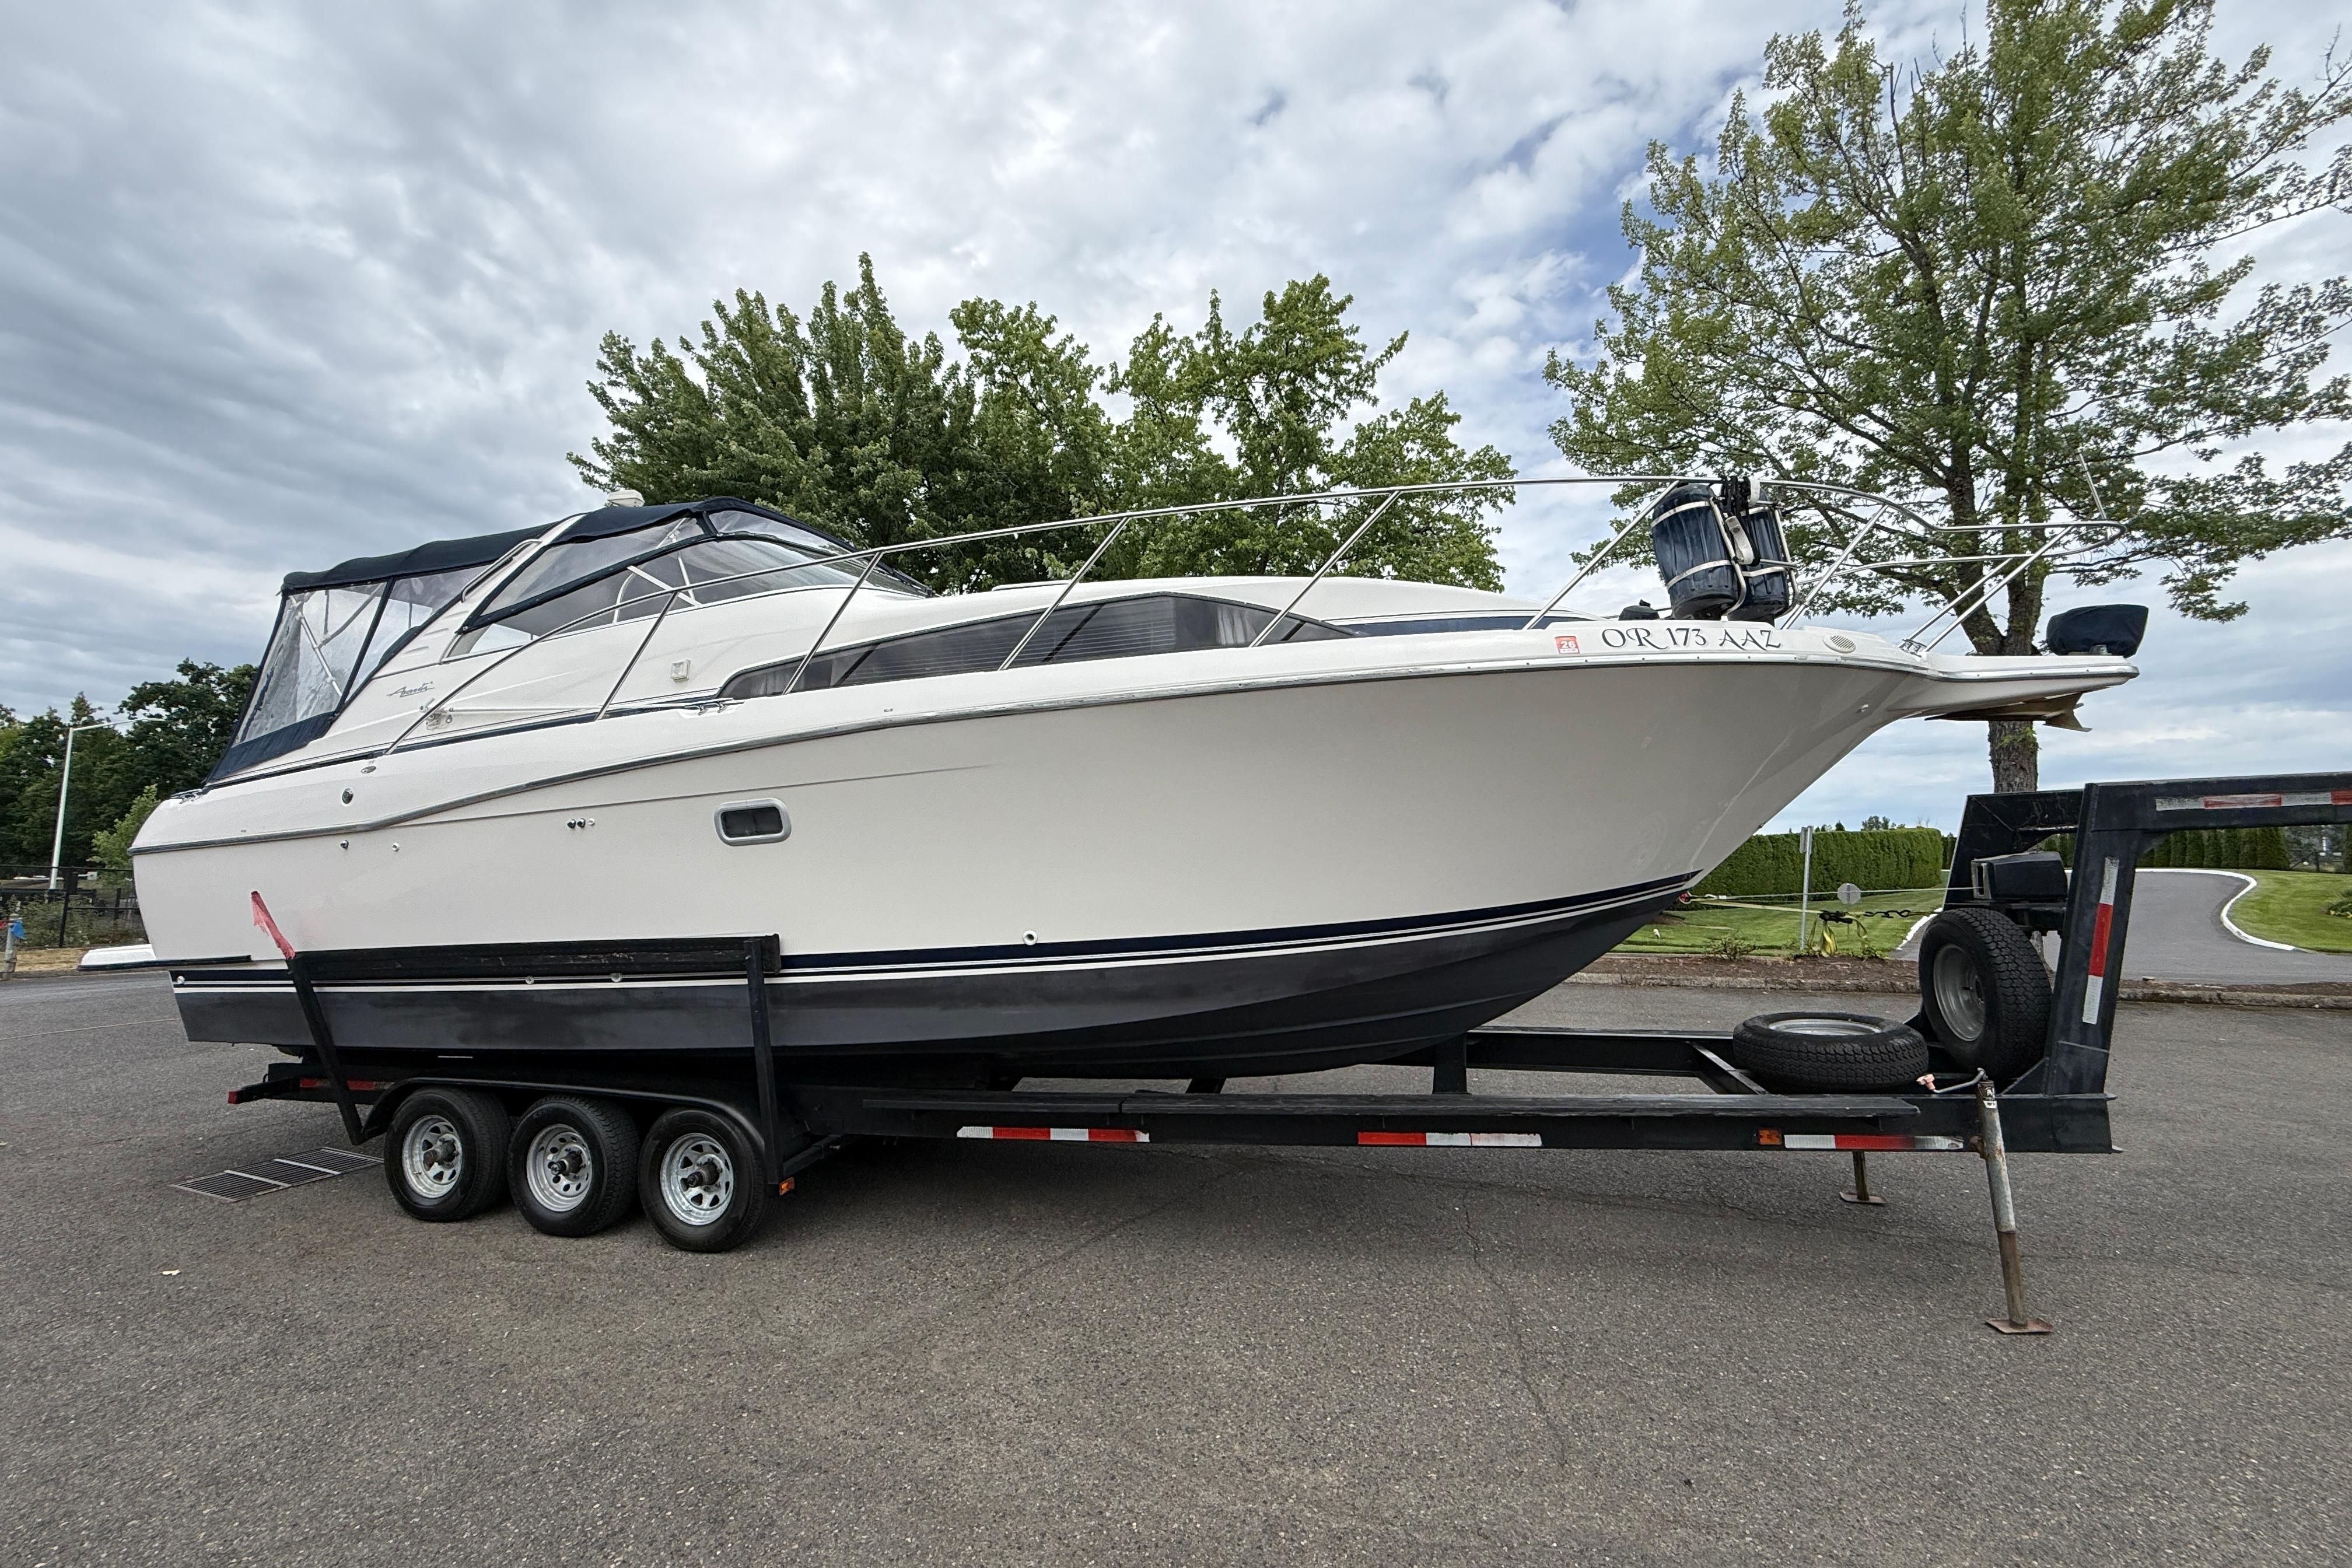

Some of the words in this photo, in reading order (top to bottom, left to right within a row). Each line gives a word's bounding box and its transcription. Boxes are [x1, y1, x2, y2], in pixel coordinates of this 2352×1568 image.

[1560, 640, 1576, 649] 26
[1602, 628, 1668, 649] OR
[1666, 628, 1706, 646] 173
[1719, 629, 1781, 651] AAZ
